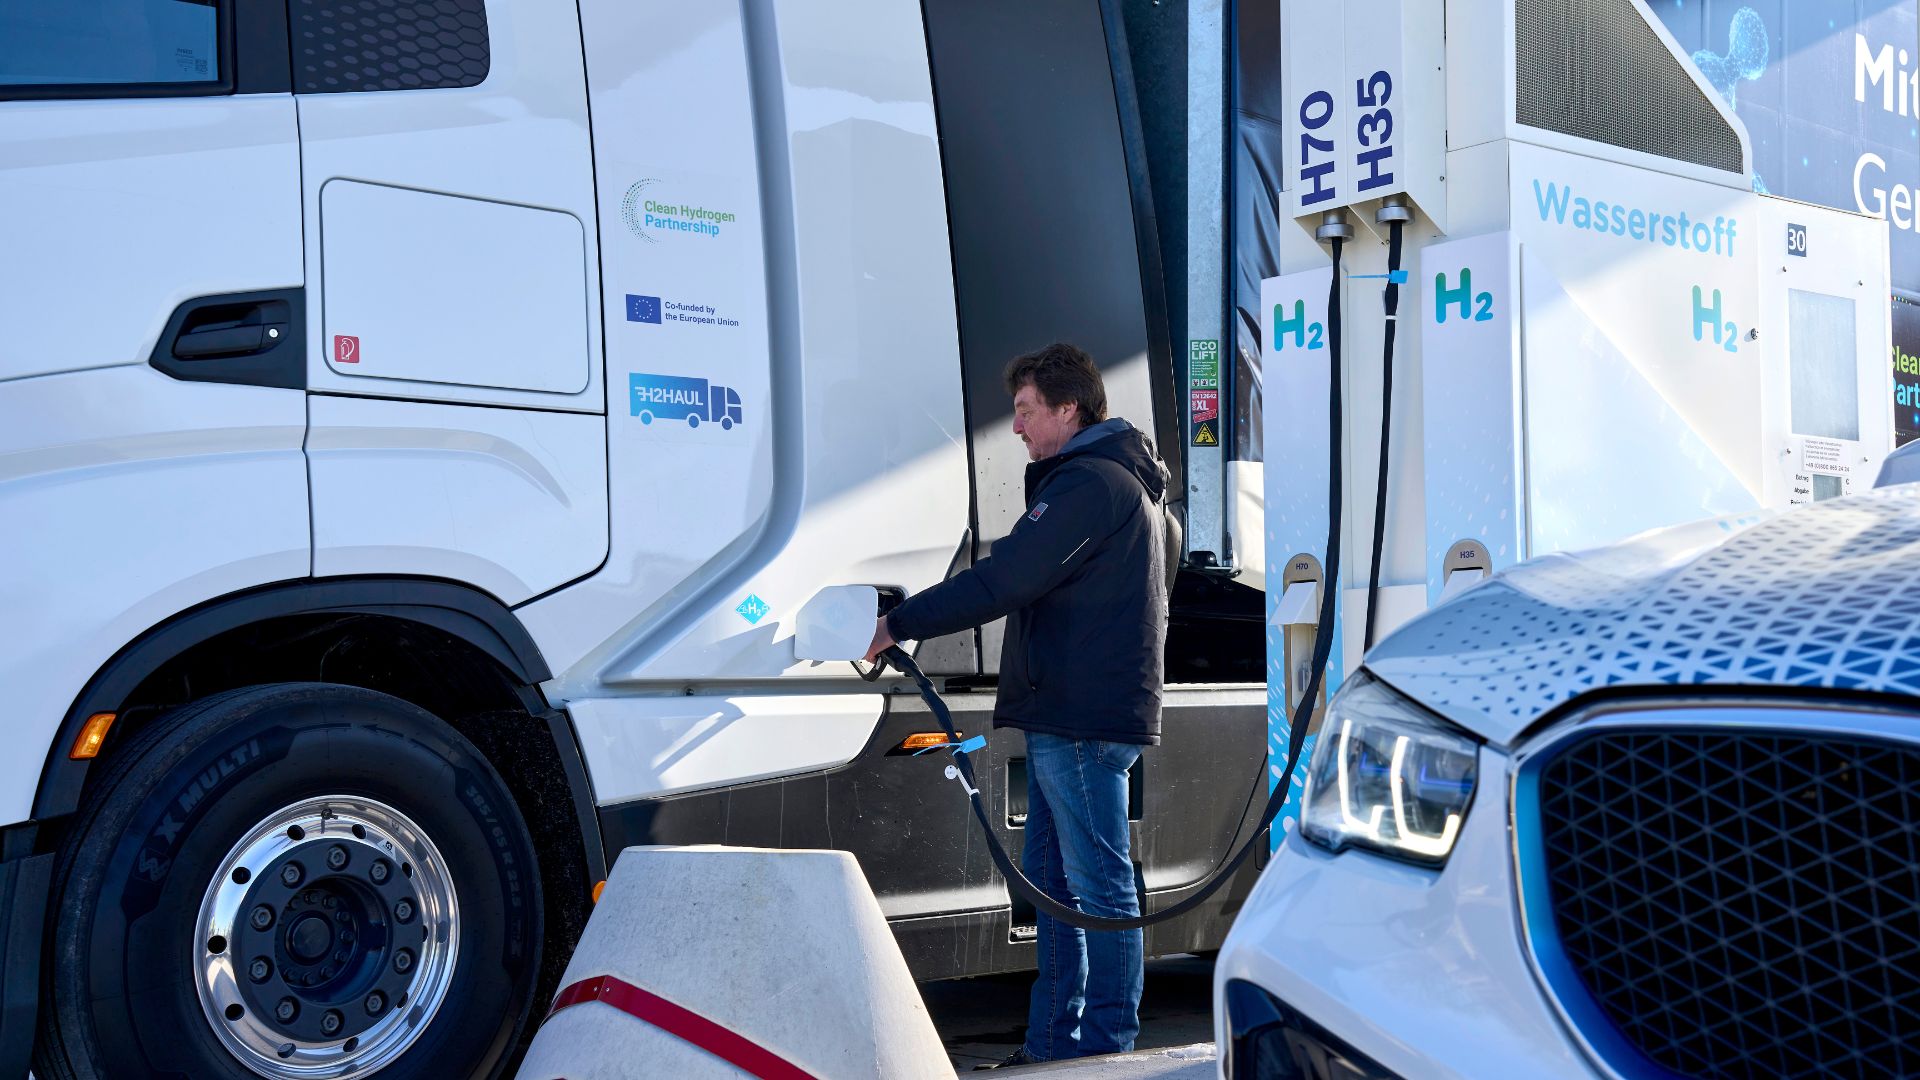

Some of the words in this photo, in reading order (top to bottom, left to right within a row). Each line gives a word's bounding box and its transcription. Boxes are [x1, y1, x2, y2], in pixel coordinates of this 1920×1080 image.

[1356, 70, 1394, 192] H35
[1299, 90, 1336, 207] H70
[644, 200, 678, 216] Clean
[680, 205, 736, 224] Hydrogen
[1532, 178, 1737, 257] Wasserstoff
[645, 214, 720, 238] Partnership
[1787, 228, 1806, 252] 30
[1435, 267, 1494, 323] H2
[664, 301, 704, 314] Co-funded
[706, 305, 715, 315] by
[665, 312, 678, 321] the
[679, 313, 716, 325] European
[717, 317, 739, 327] Union
[1691, 284, 1738, 353] H2
[1273, 299, 1324, 352] H2
[1191, 341, 1217, 351] ECO
[1191, 350, 1217, 360] LIFT
[634, 386, 704, 406] H2HAUL
[1197, 400, 1210, 411] XL
[1460, 551, 1475, 559] H35
[178, 739, 261, 813] MULTI
